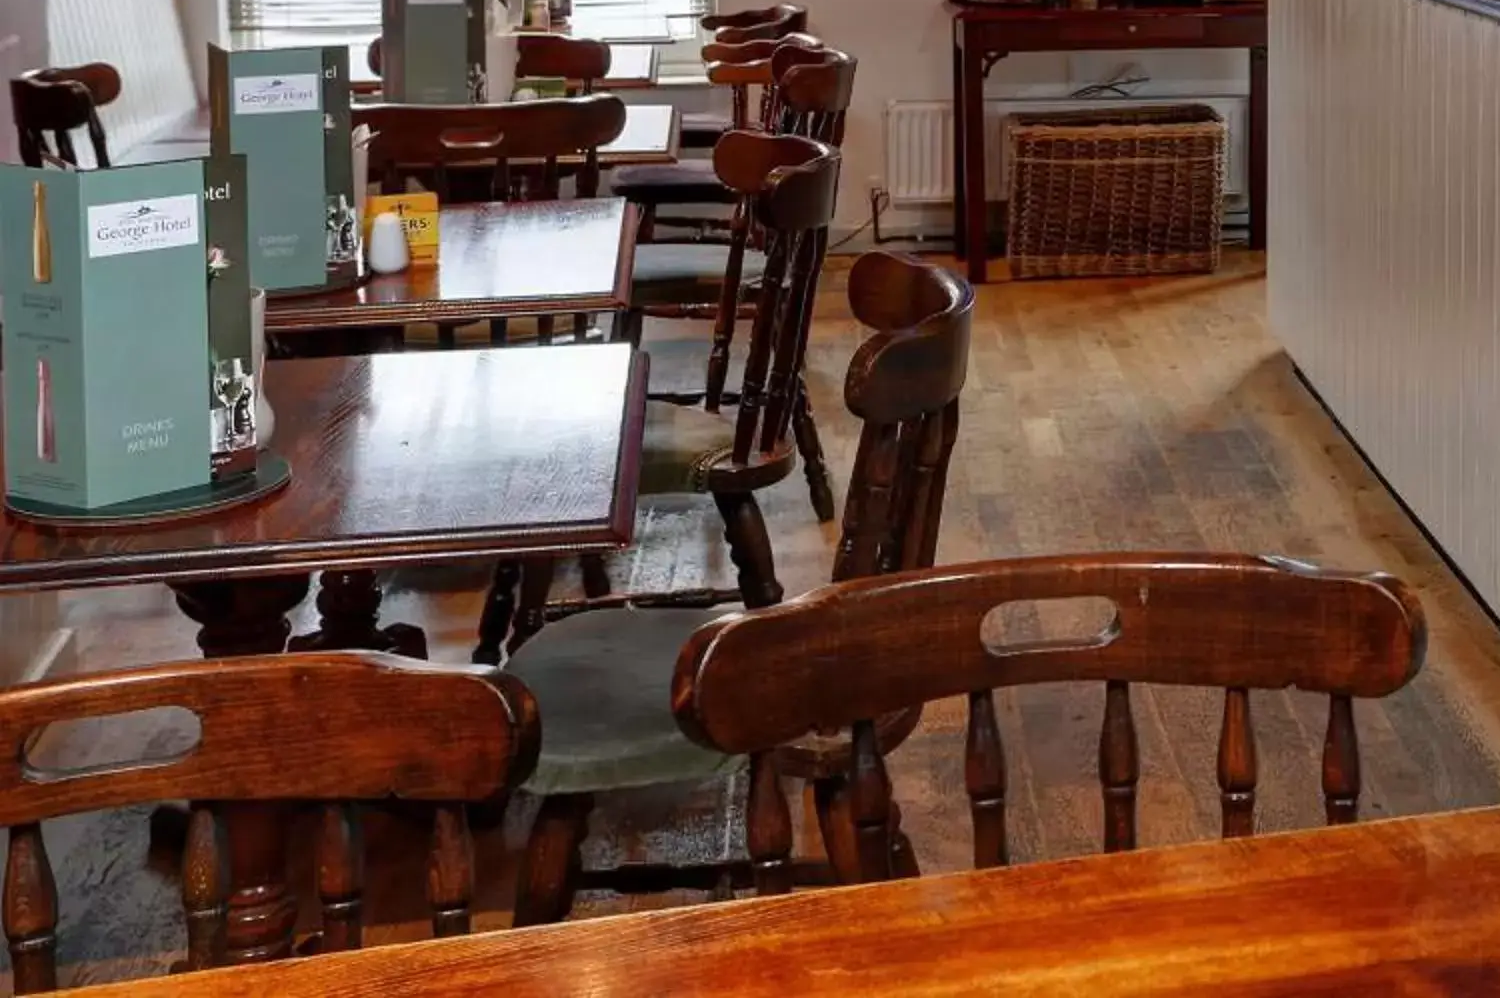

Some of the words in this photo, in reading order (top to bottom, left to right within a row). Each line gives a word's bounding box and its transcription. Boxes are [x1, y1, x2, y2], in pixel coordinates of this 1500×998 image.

[97, 223, 150, 242] George
[153, 217, 192, 233] Hotel
[121, 417, 175, 439] DRINKS
[127, 434, 169, 453] MENU
